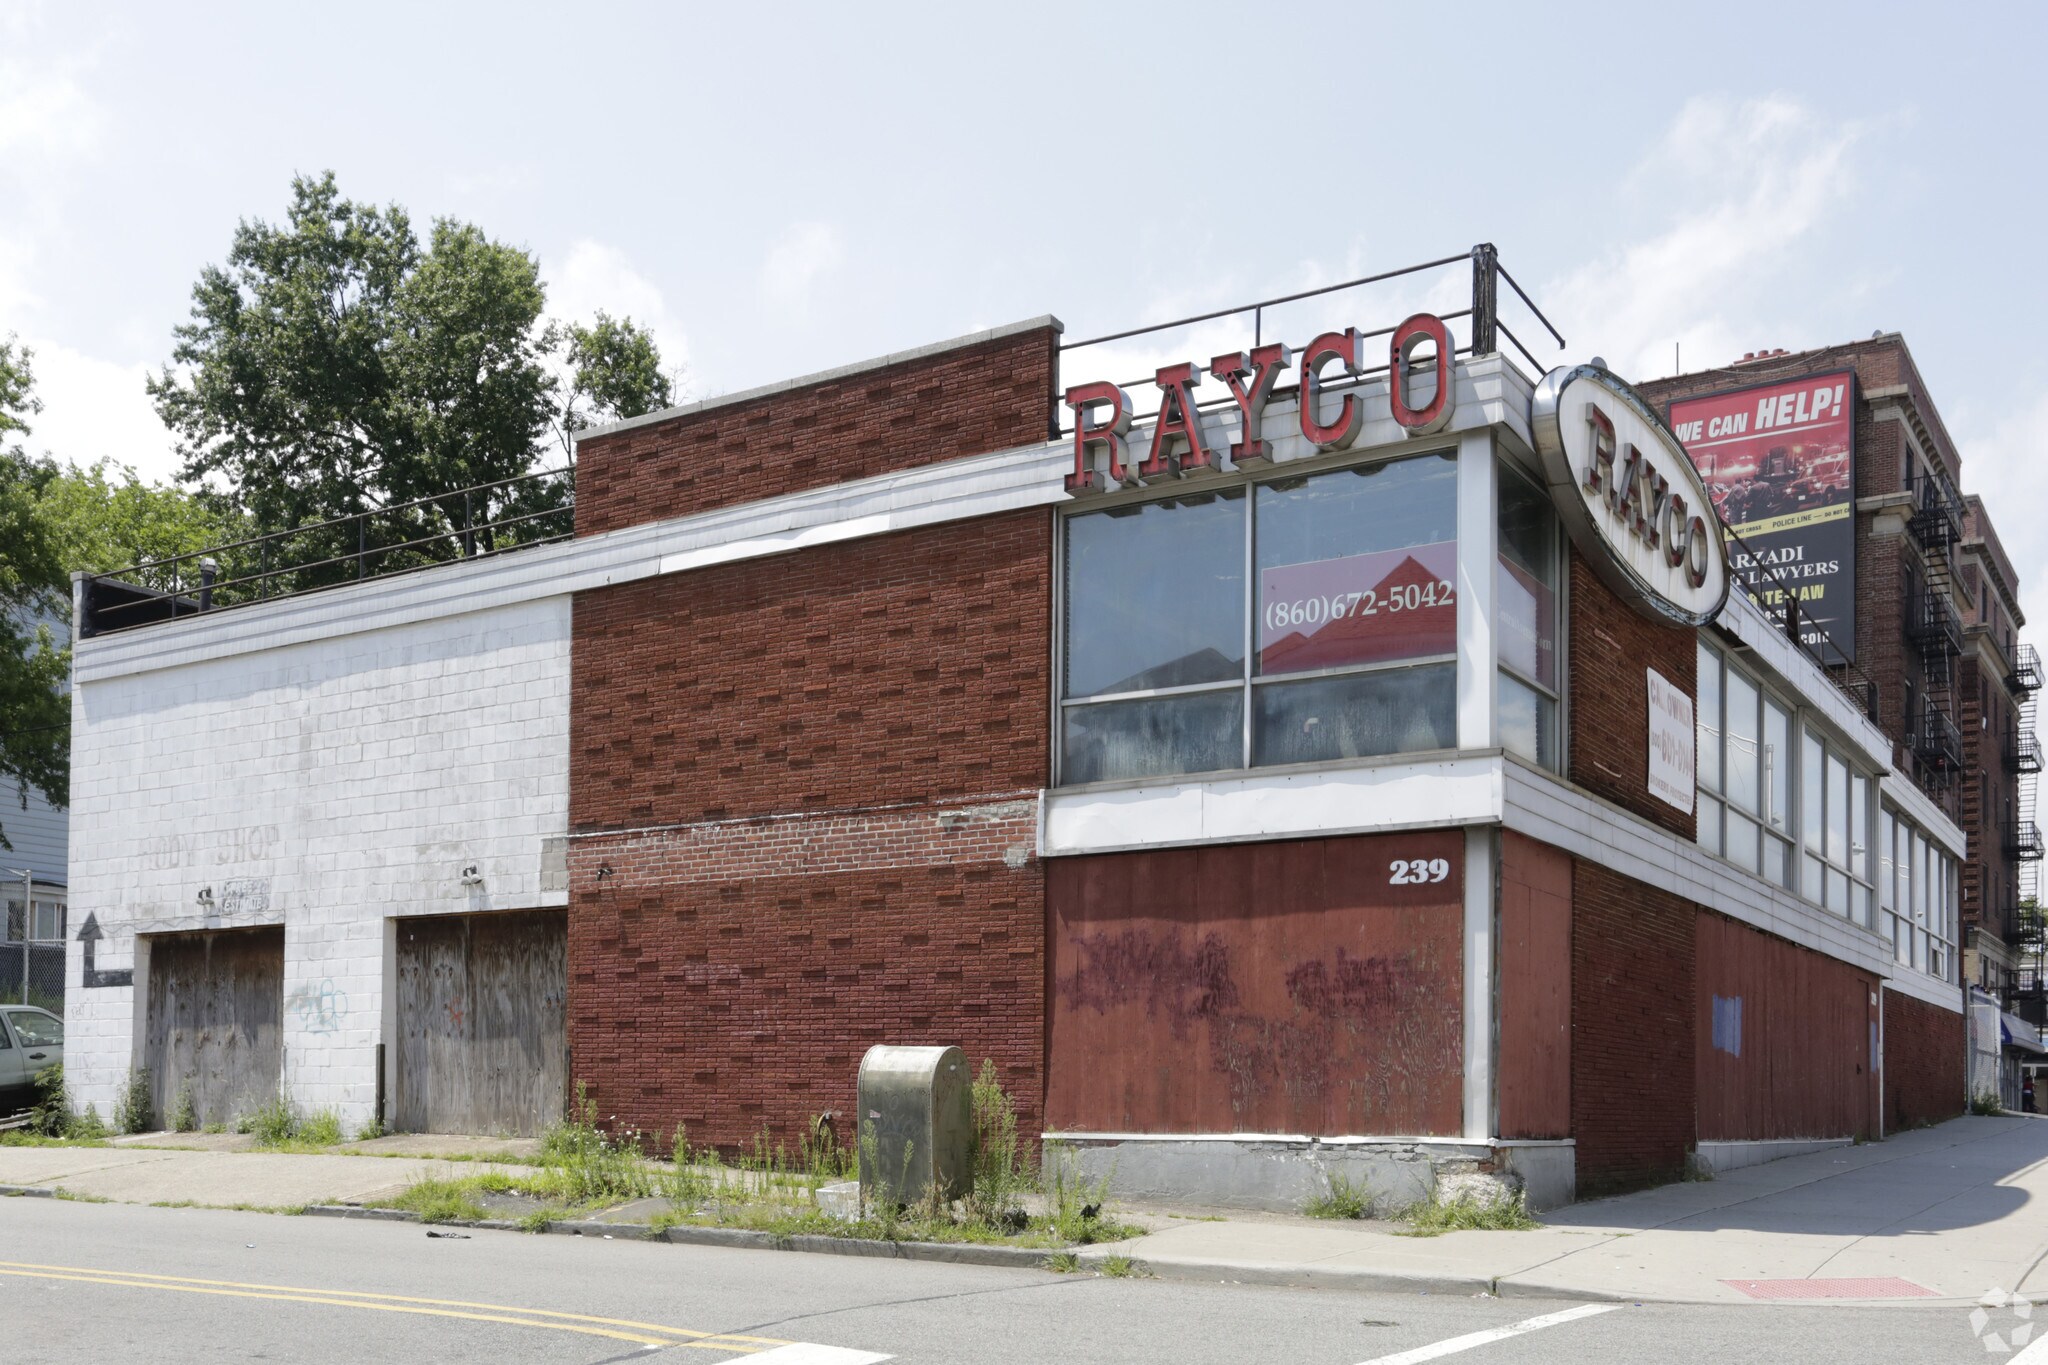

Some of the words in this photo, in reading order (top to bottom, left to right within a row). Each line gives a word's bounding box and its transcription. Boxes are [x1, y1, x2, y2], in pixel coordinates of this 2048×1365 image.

[1064, 313, 1456, 498] RAYCO
[1675, 420, 1703, 442] WE
[1708, 412, 1748, 438] CAN
[1754, 385, 1845, 430] HELP!
[1583, 402, 1708, 588] RAYCO
[1772, 518, 1796, 528] POLICE
[1797, 514, 1812, 522] LINE
[1749, 560, 1839, 584] LAWYERS
[1266, 580, 1454, 630] (860)672-5042
[1667, 691, 1692, 729] OWNER
[217, 825, 279, 864] SHOP
[1389, 858, 1449, 884] 239
